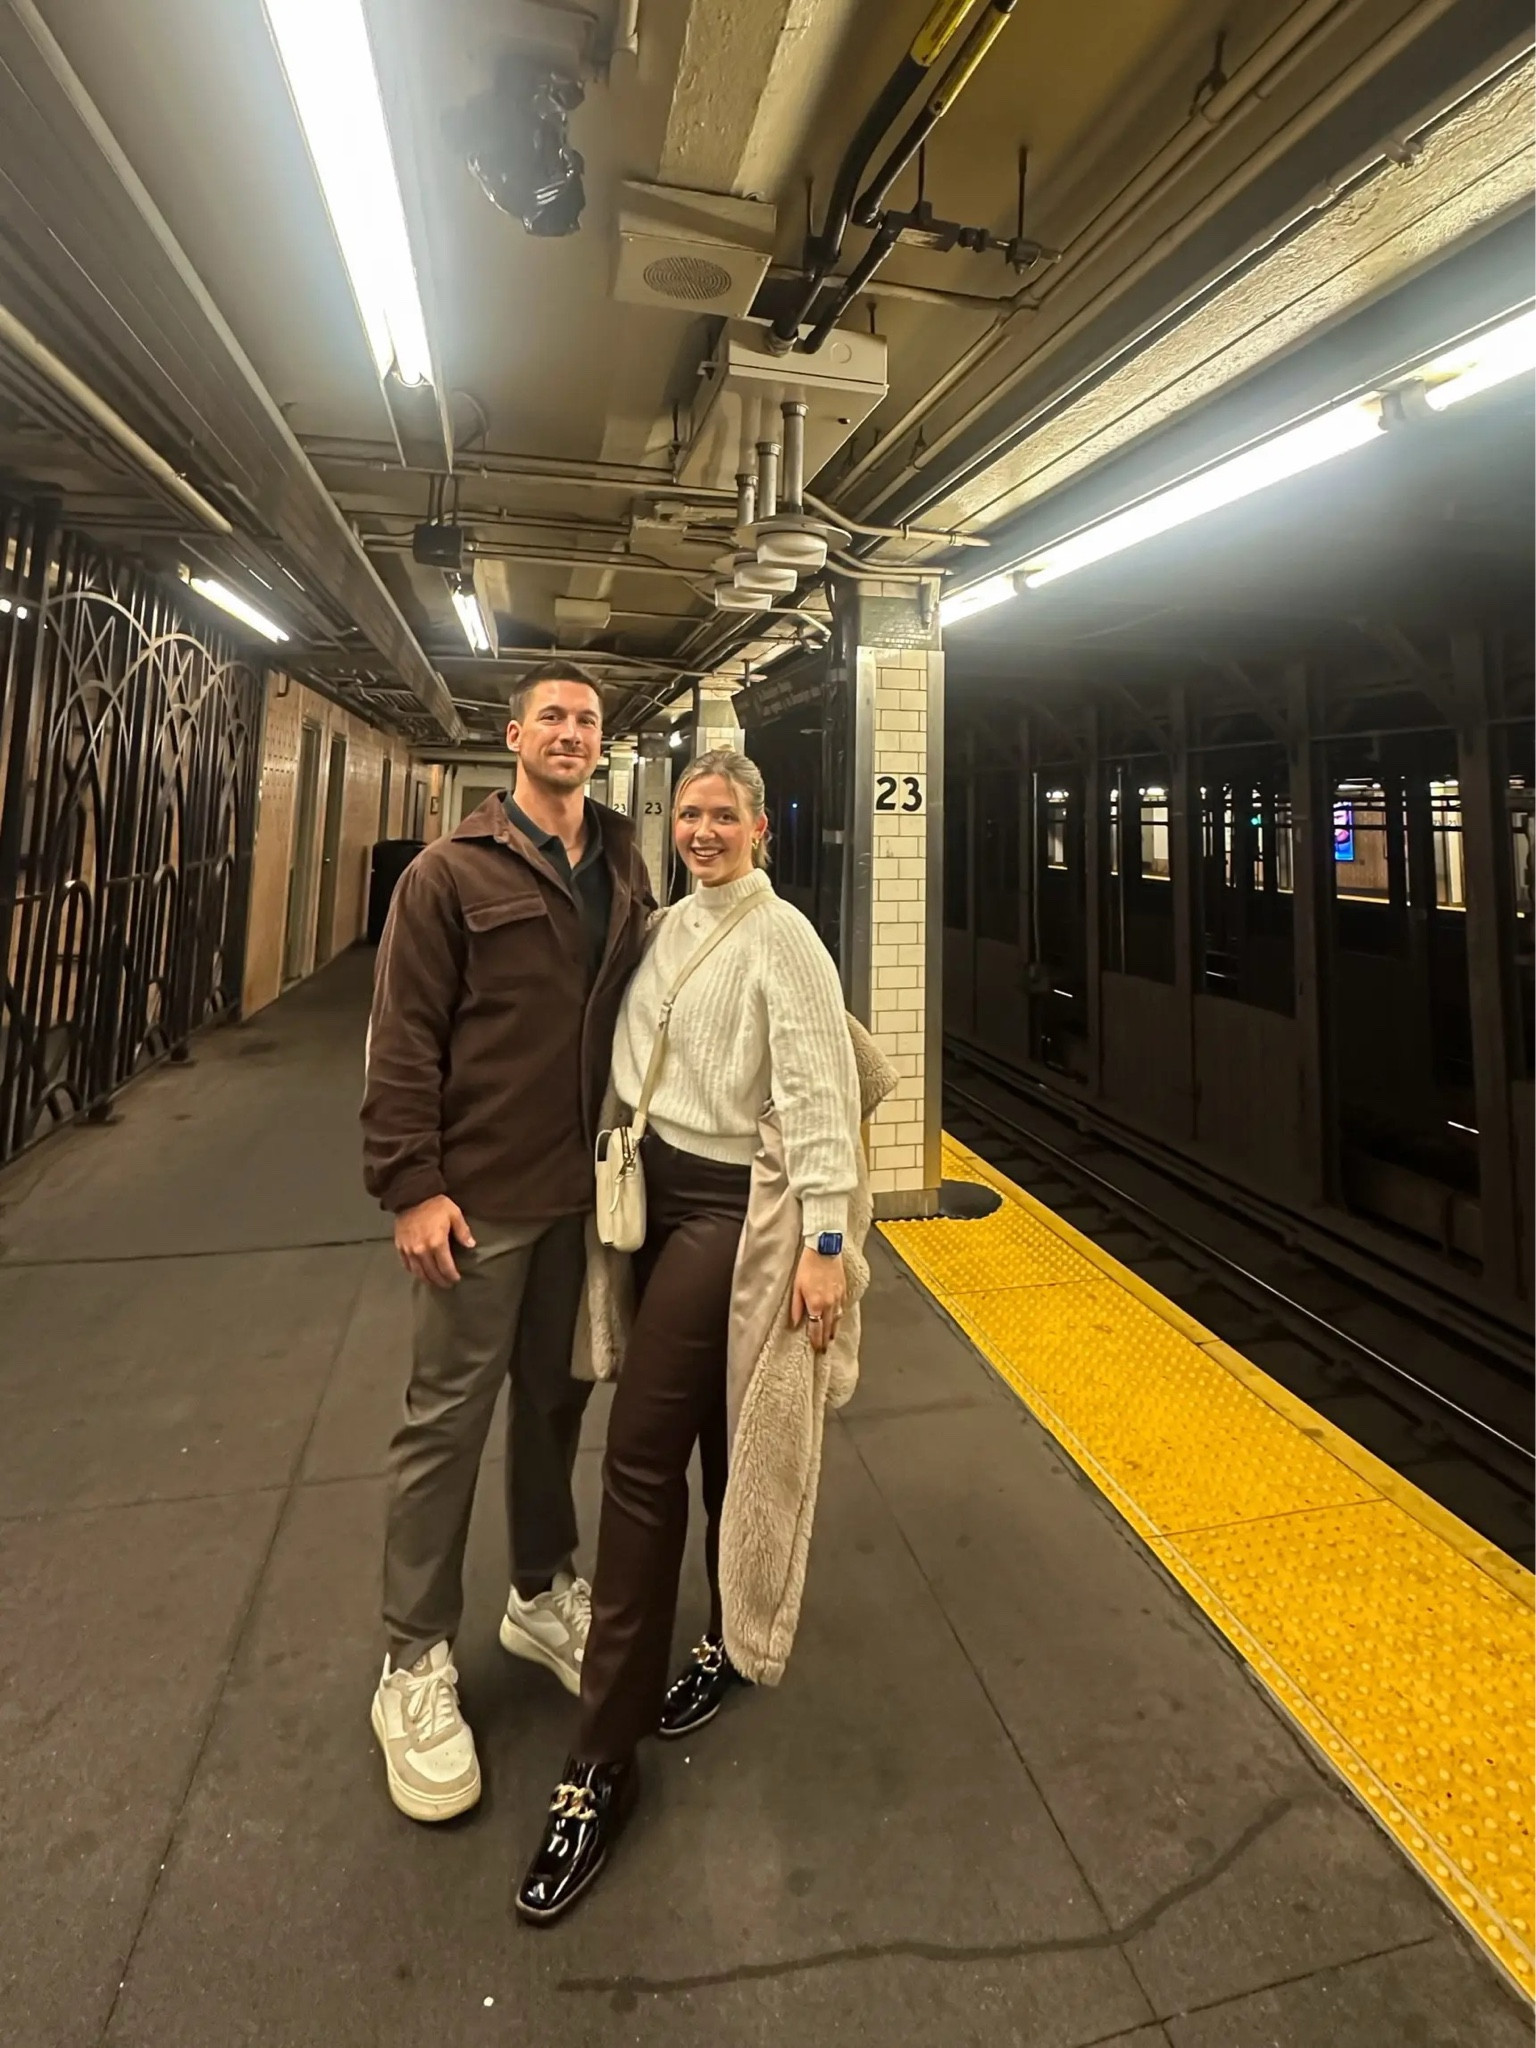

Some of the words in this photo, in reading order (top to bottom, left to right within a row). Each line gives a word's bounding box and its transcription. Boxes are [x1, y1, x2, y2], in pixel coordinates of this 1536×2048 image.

[876, 776, 922, 812] 23
[613, 803, 626, 814] 23
[645, 802, 663, 815] 23
